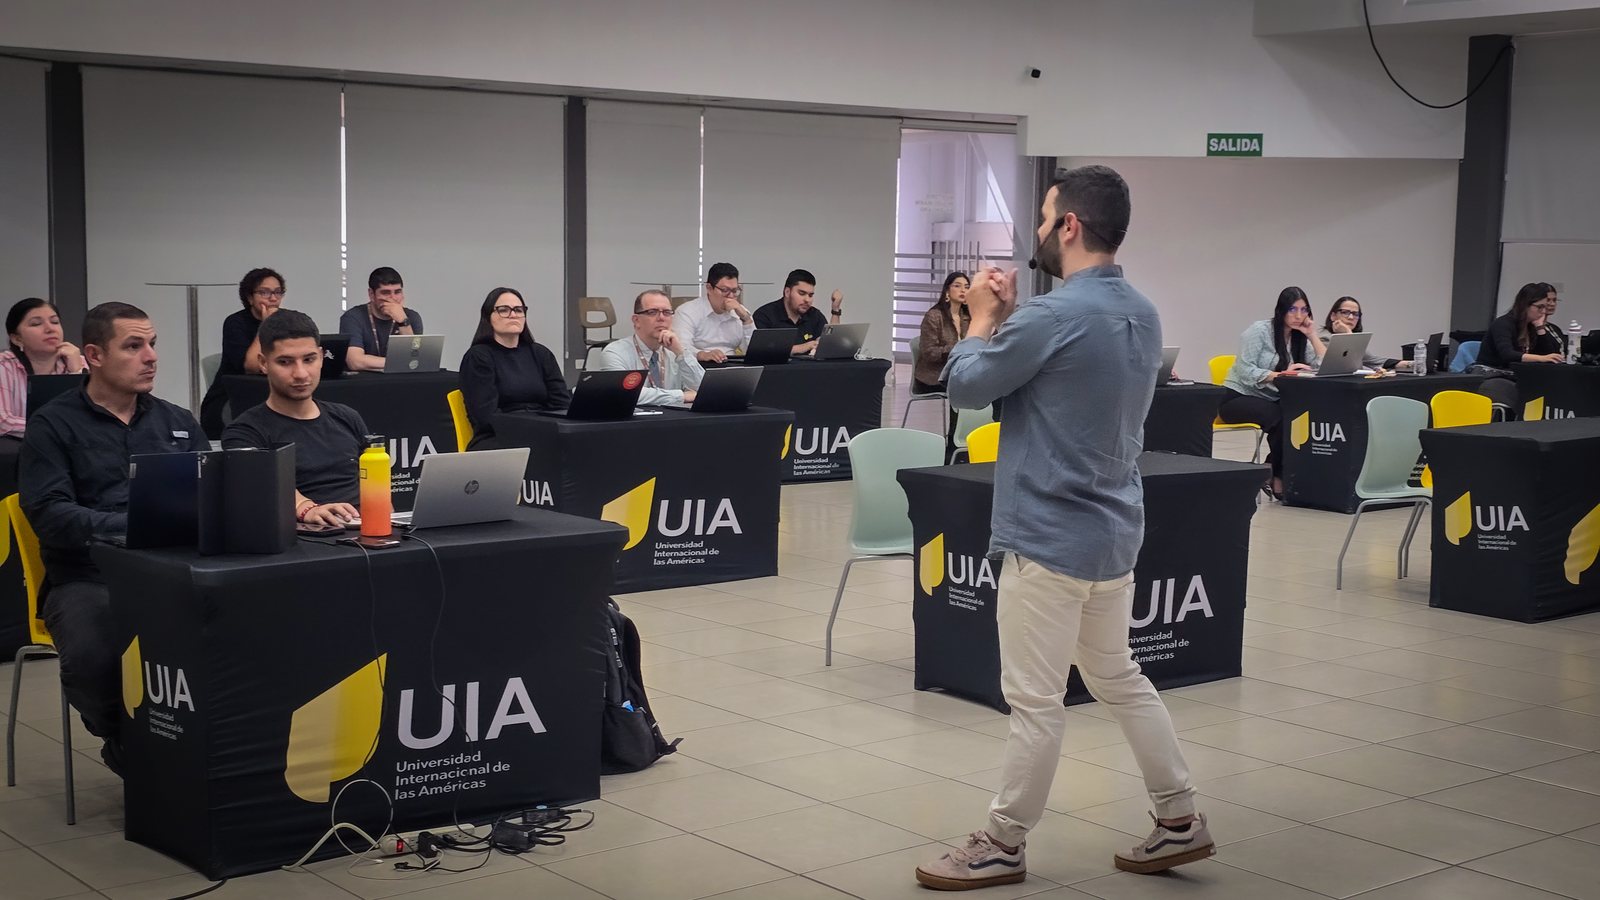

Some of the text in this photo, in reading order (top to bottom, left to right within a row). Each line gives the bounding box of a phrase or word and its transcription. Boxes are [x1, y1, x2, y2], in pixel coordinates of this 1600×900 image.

[1209, 137, 1260, 152] SALIDA
[795, 426, 851, 455] UIA
[1311, 421, 1347, 442] UIA
[389, 435, 438, 469] IA
[522, 479, 554, 506] UIA
[657, 498, 743, 537] UIA
[1475, 505, 1530, 531] UIA
[654, 548, 708, 558] Internacional
[655, 540, 704, 549] Universidad
[653, 557, 705, 566] las Américas
[947, 551, 998, 590] UIA
[1129, 574, 1214, 628] UIA
[1129, 630, 1173, 644] niversidad
[1132, 638, 1190, 654] ernacional de
[1134, 652, 1175, 663] Américas
[144, 660, 195, 712] UIA
[398, 676, 548, 750] UIA
[396, 750, 481, 773] Universidad
[395, 761, 511, 787] Internacional de
[394, 780, 487, 800] las Américas
